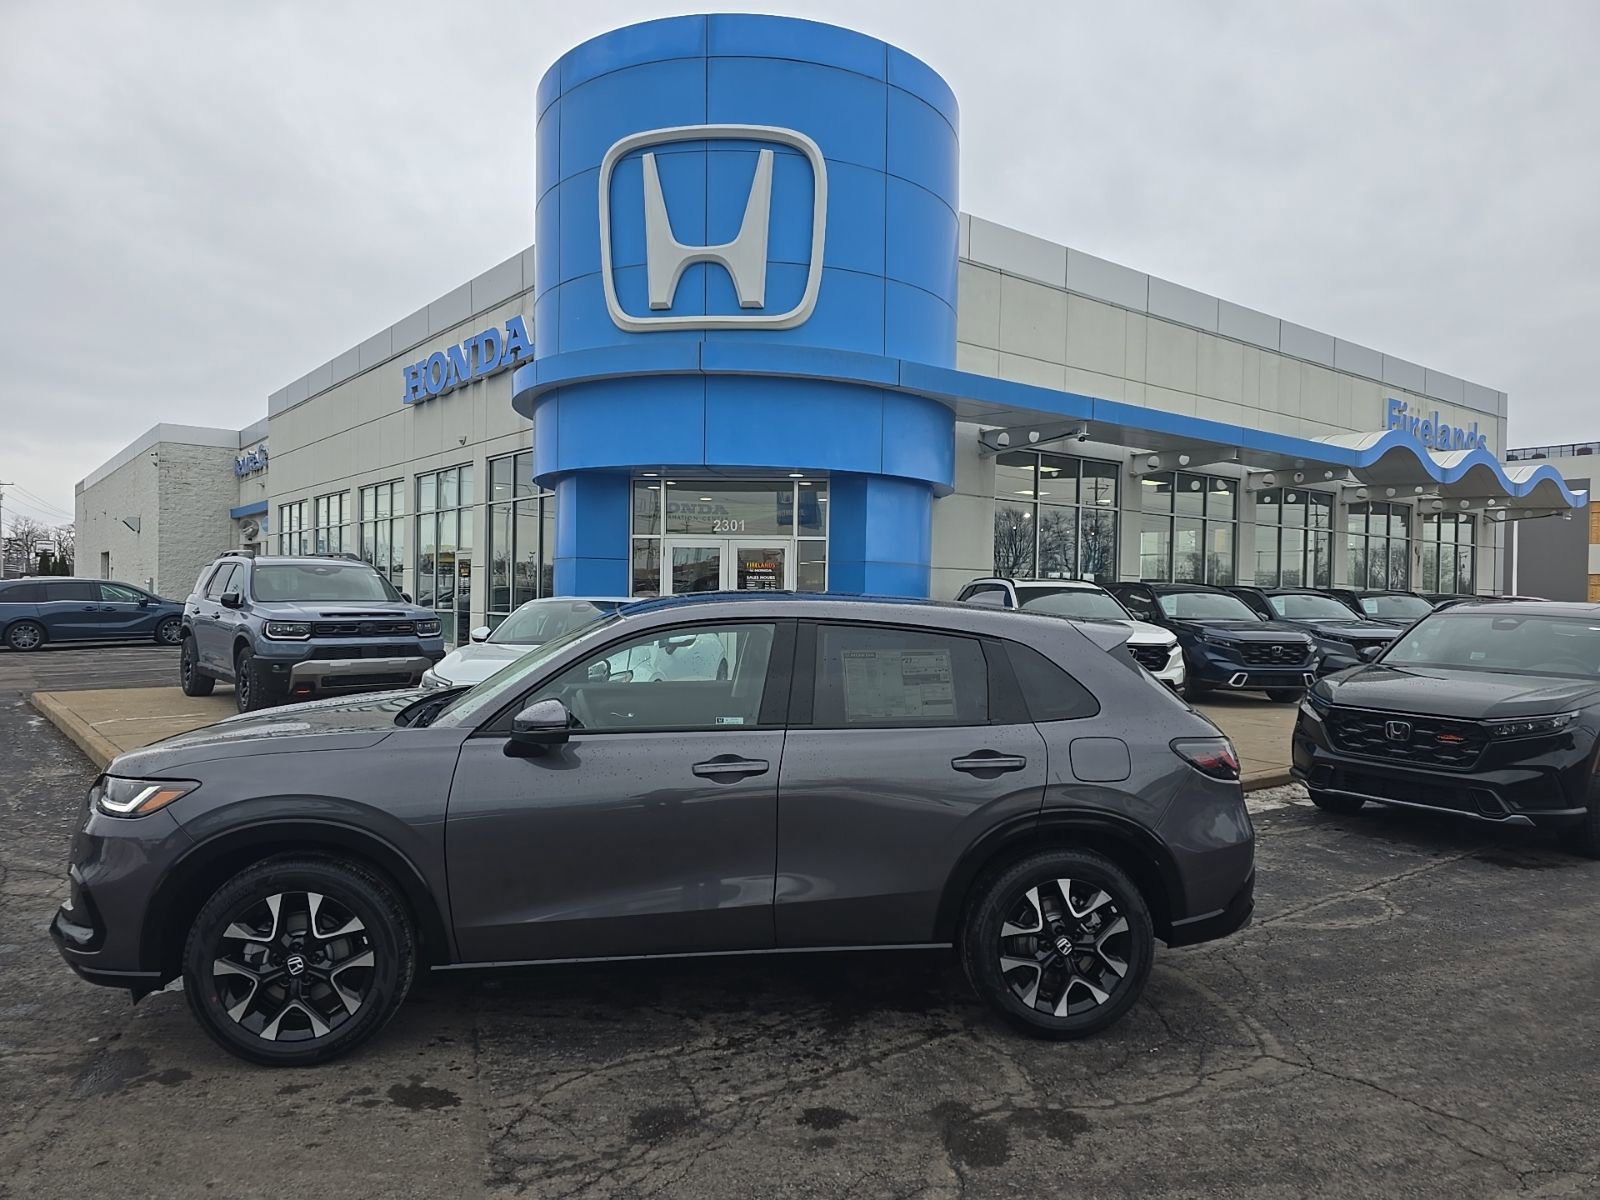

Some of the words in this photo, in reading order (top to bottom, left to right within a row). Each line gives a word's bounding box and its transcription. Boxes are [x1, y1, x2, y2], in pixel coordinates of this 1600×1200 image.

[403, 314, 535, 405] HONDA
[1385, 398, 1488, 451] Firelands
[713, 519, 745, 532] 2301
